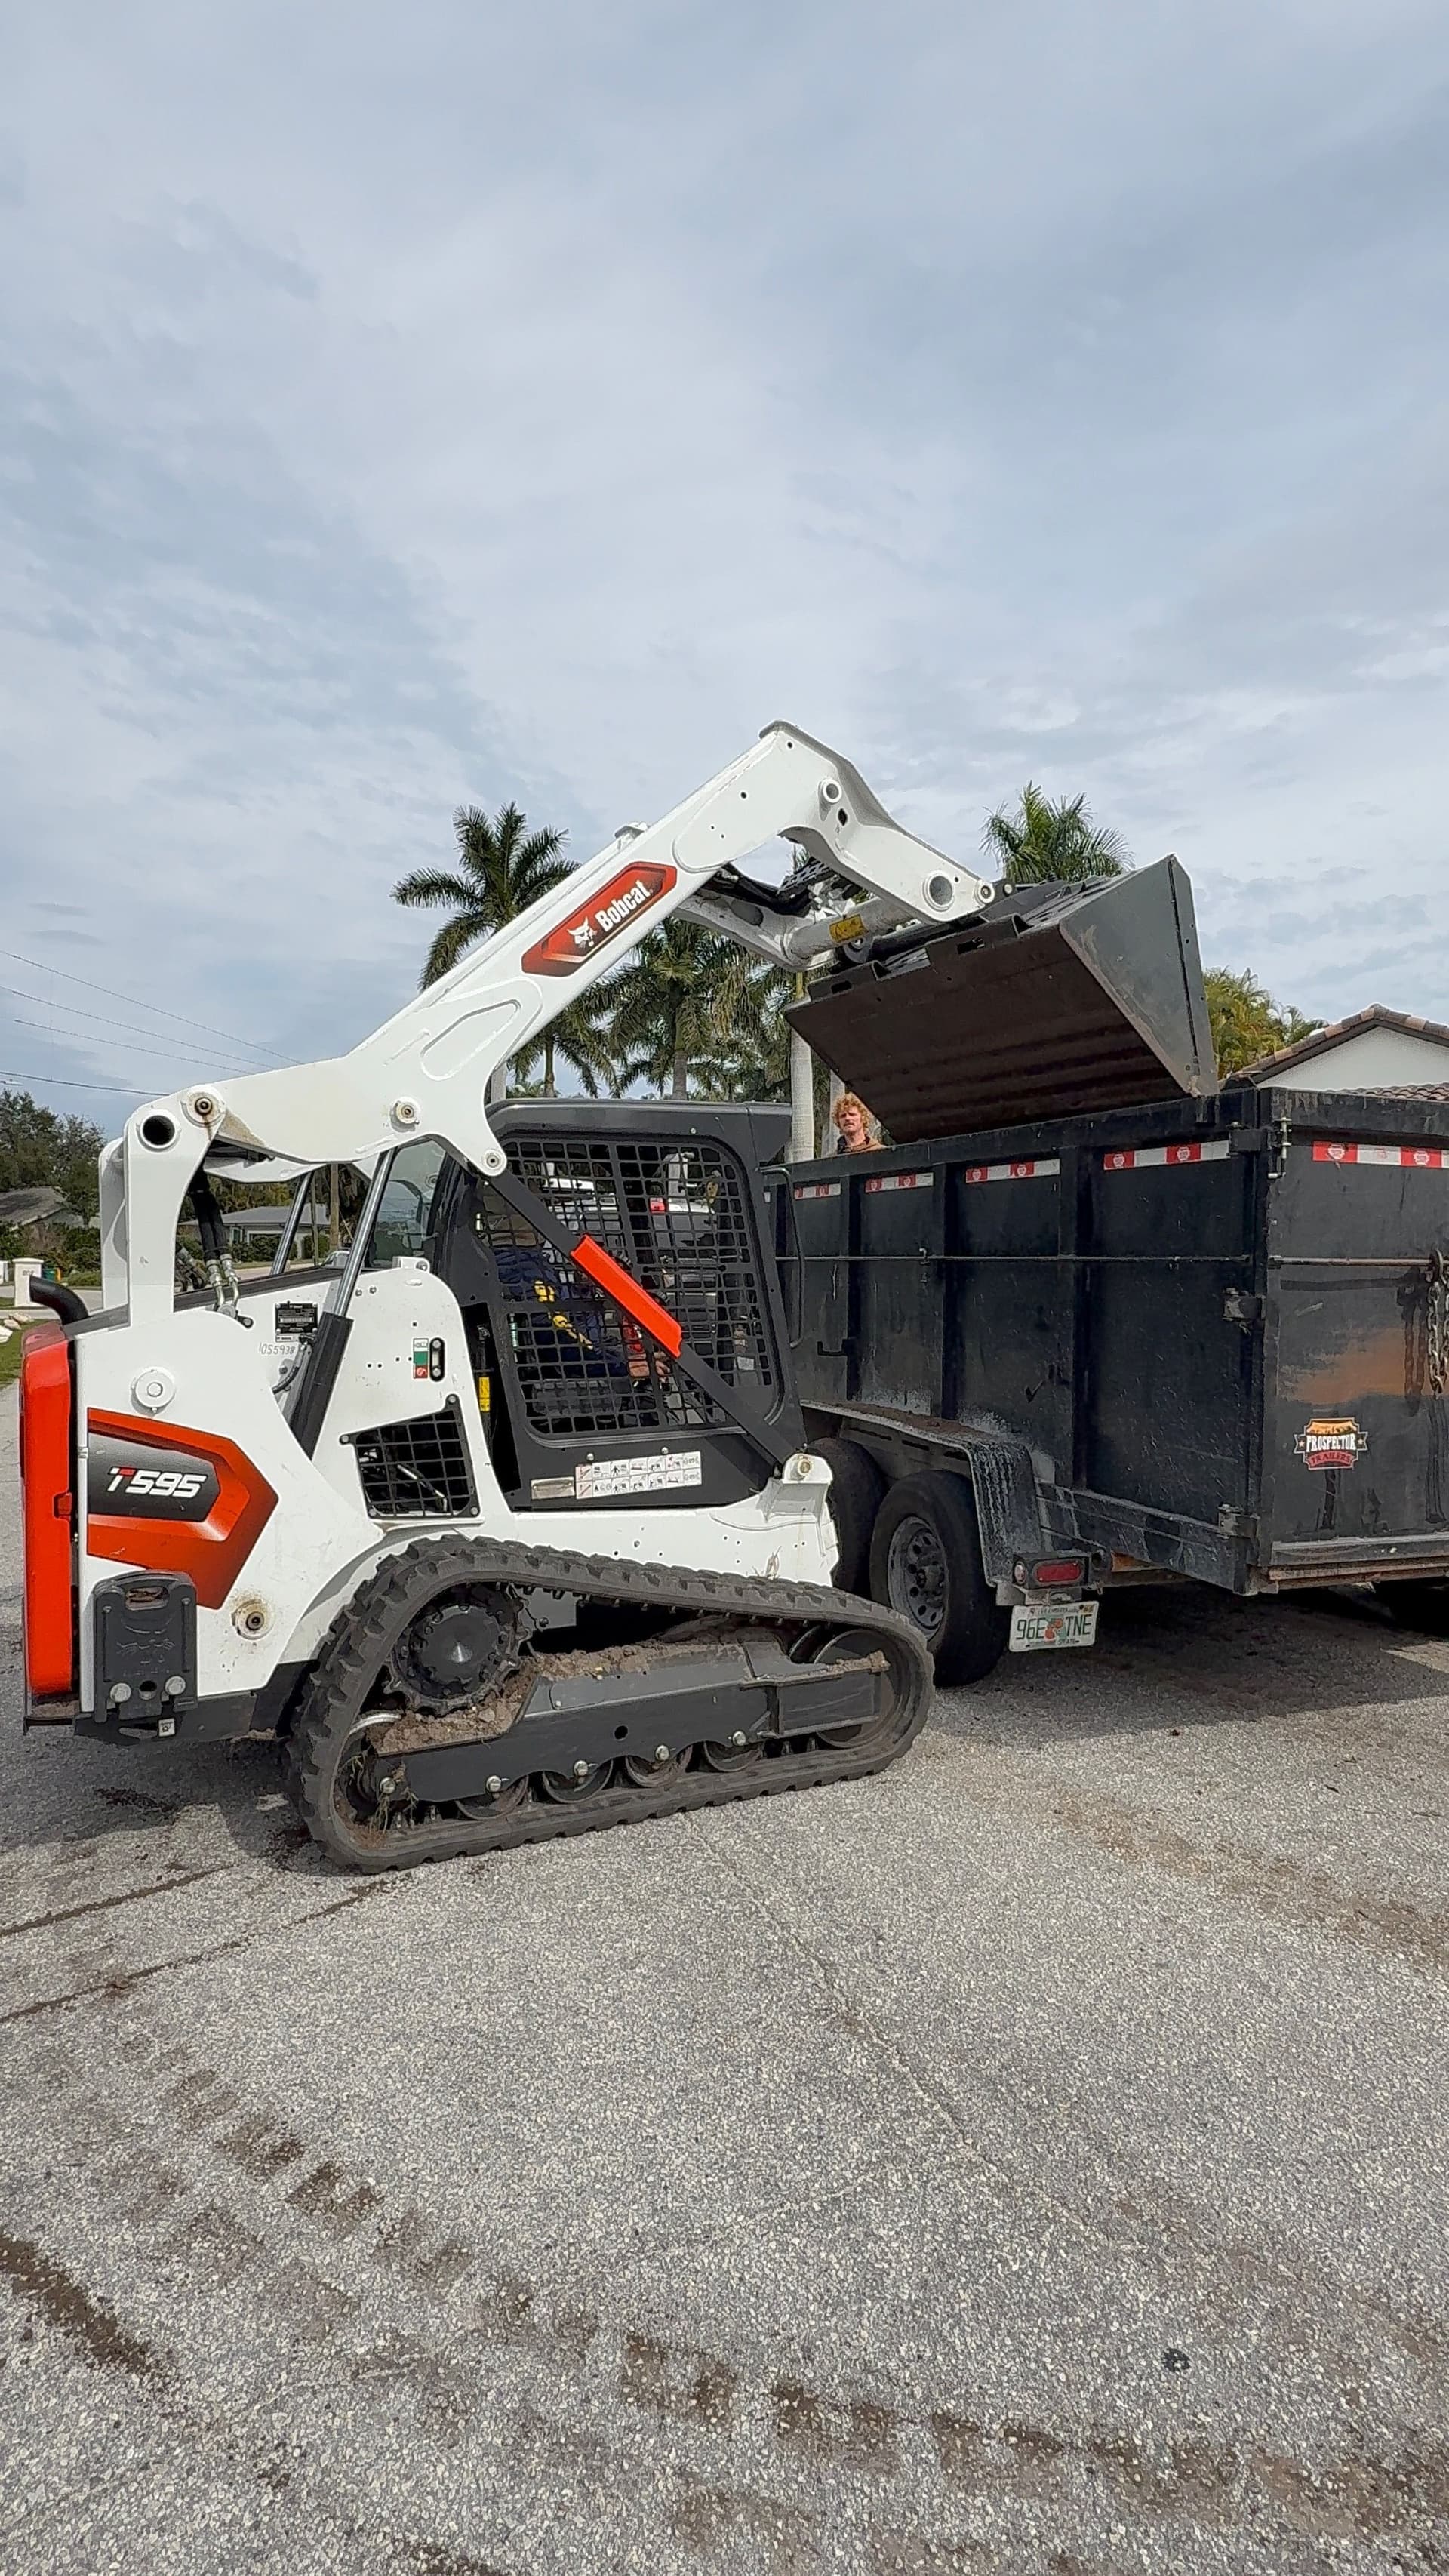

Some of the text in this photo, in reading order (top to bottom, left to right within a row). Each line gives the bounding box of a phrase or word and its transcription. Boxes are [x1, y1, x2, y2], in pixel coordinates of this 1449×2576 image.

[595, 880, 651, 932] Bobcat
[1306, 1433, 1356, 1453] PROSPECTOR
[1311, 1451, 1351, 1463] TRAILERS
[107, 1467, 208, 1498] T595
[1016, 1614, 1092, 1639] 96E TNE
